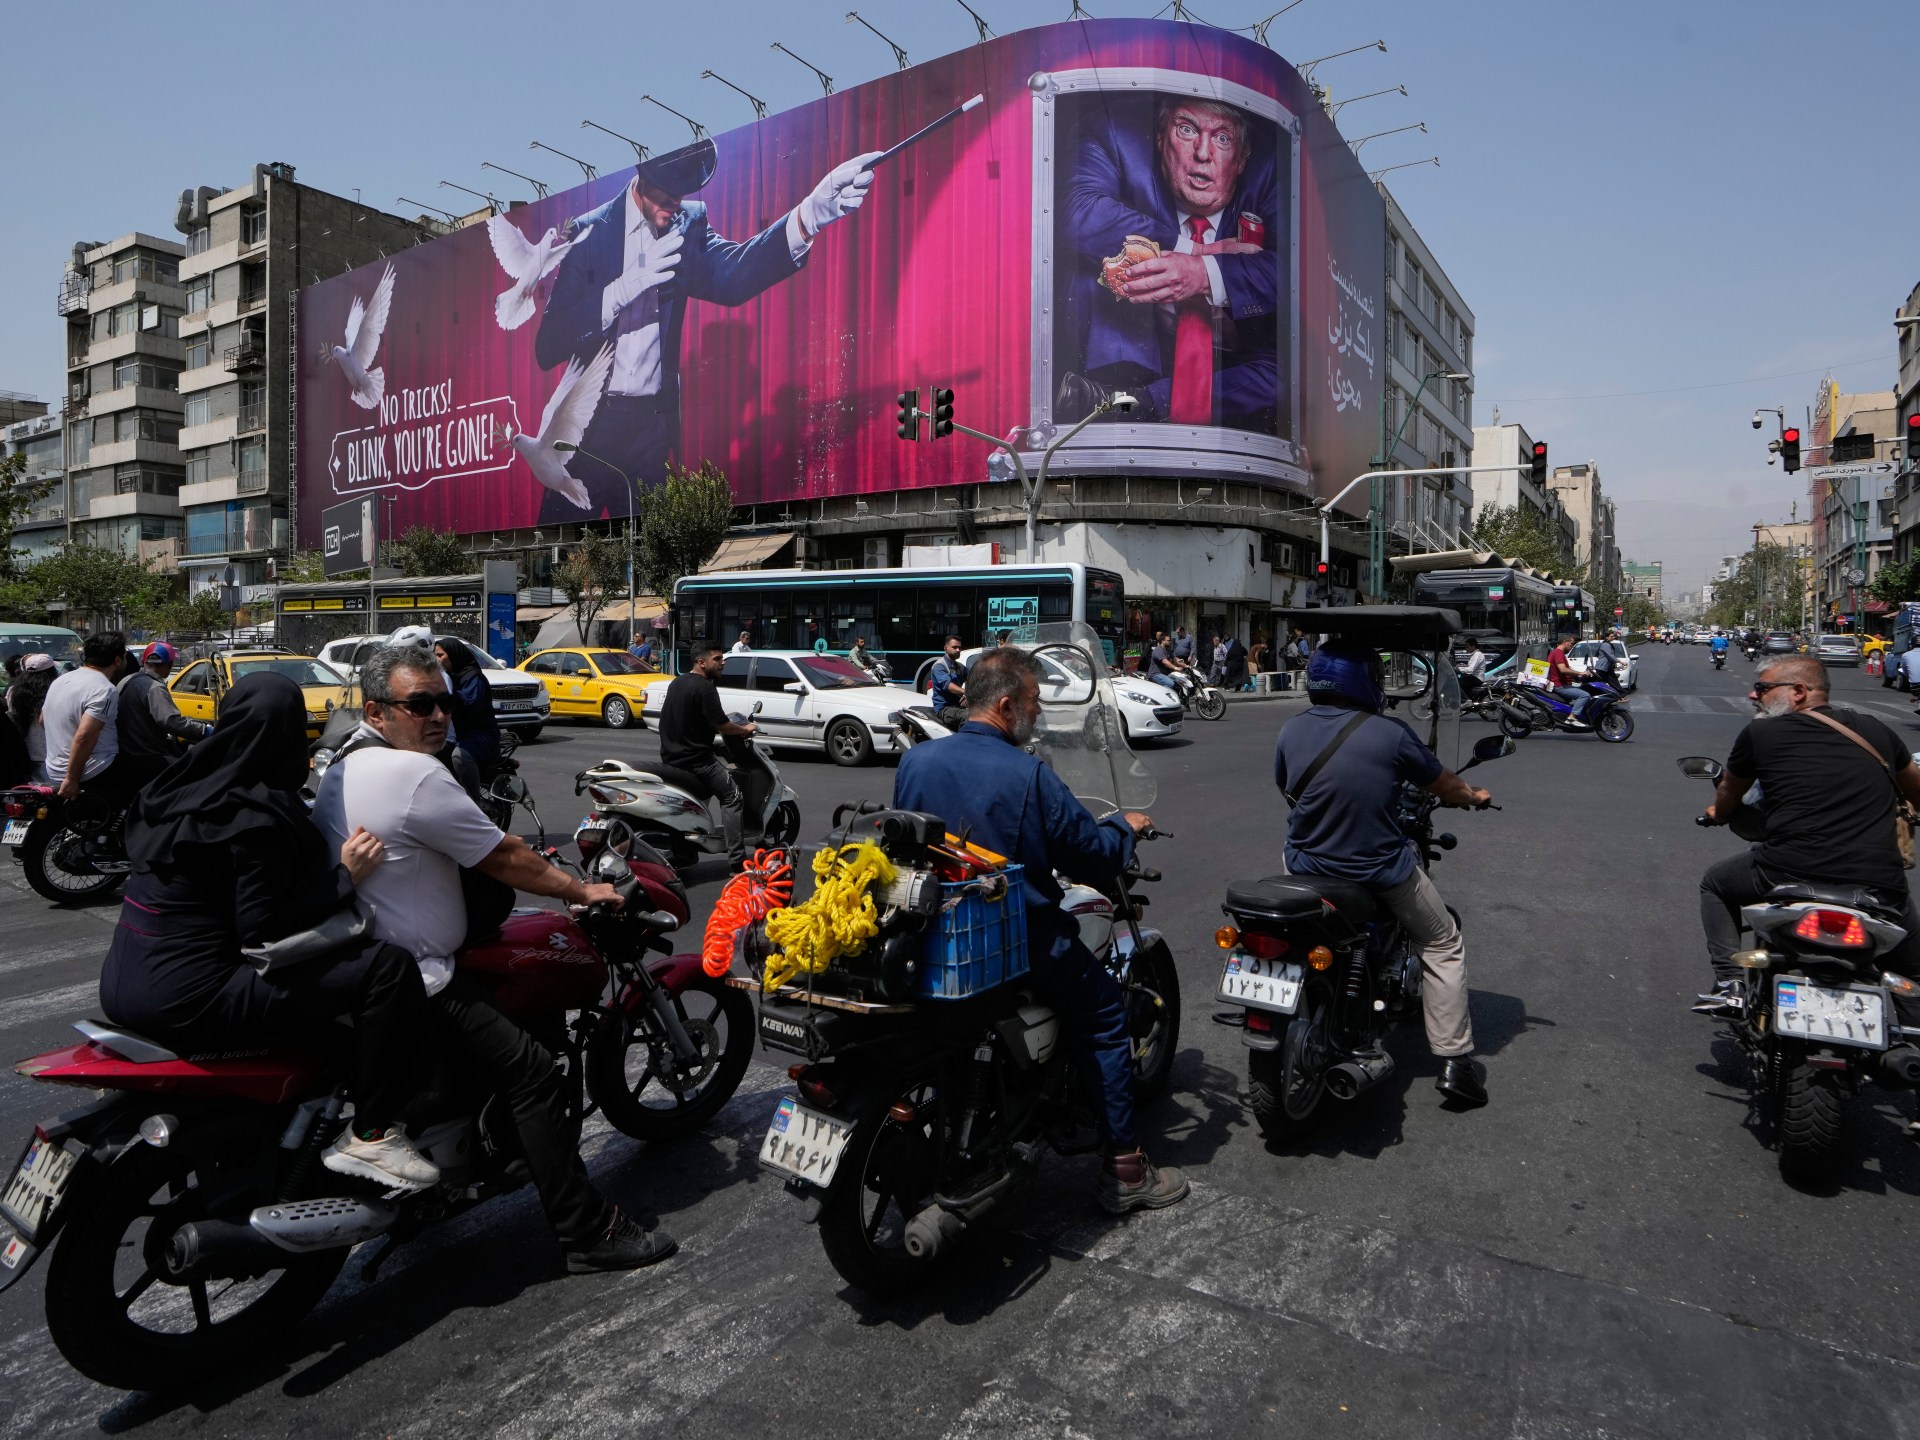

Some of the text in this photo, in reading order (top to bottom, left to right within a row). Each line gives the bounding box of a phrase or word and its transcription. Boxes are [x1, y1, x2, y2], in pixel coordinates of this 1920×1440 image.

[1353, 320, 1375, 380] پلک
[380, 378, 452, 427] NO TRICKS!
[348, 413, 494, 483] BLINK, YOU'RE GONE!
[1815, 467, 1866, 476] جمهوری اسلامی
[763, 1016, 804, 1038] KEEWAY
